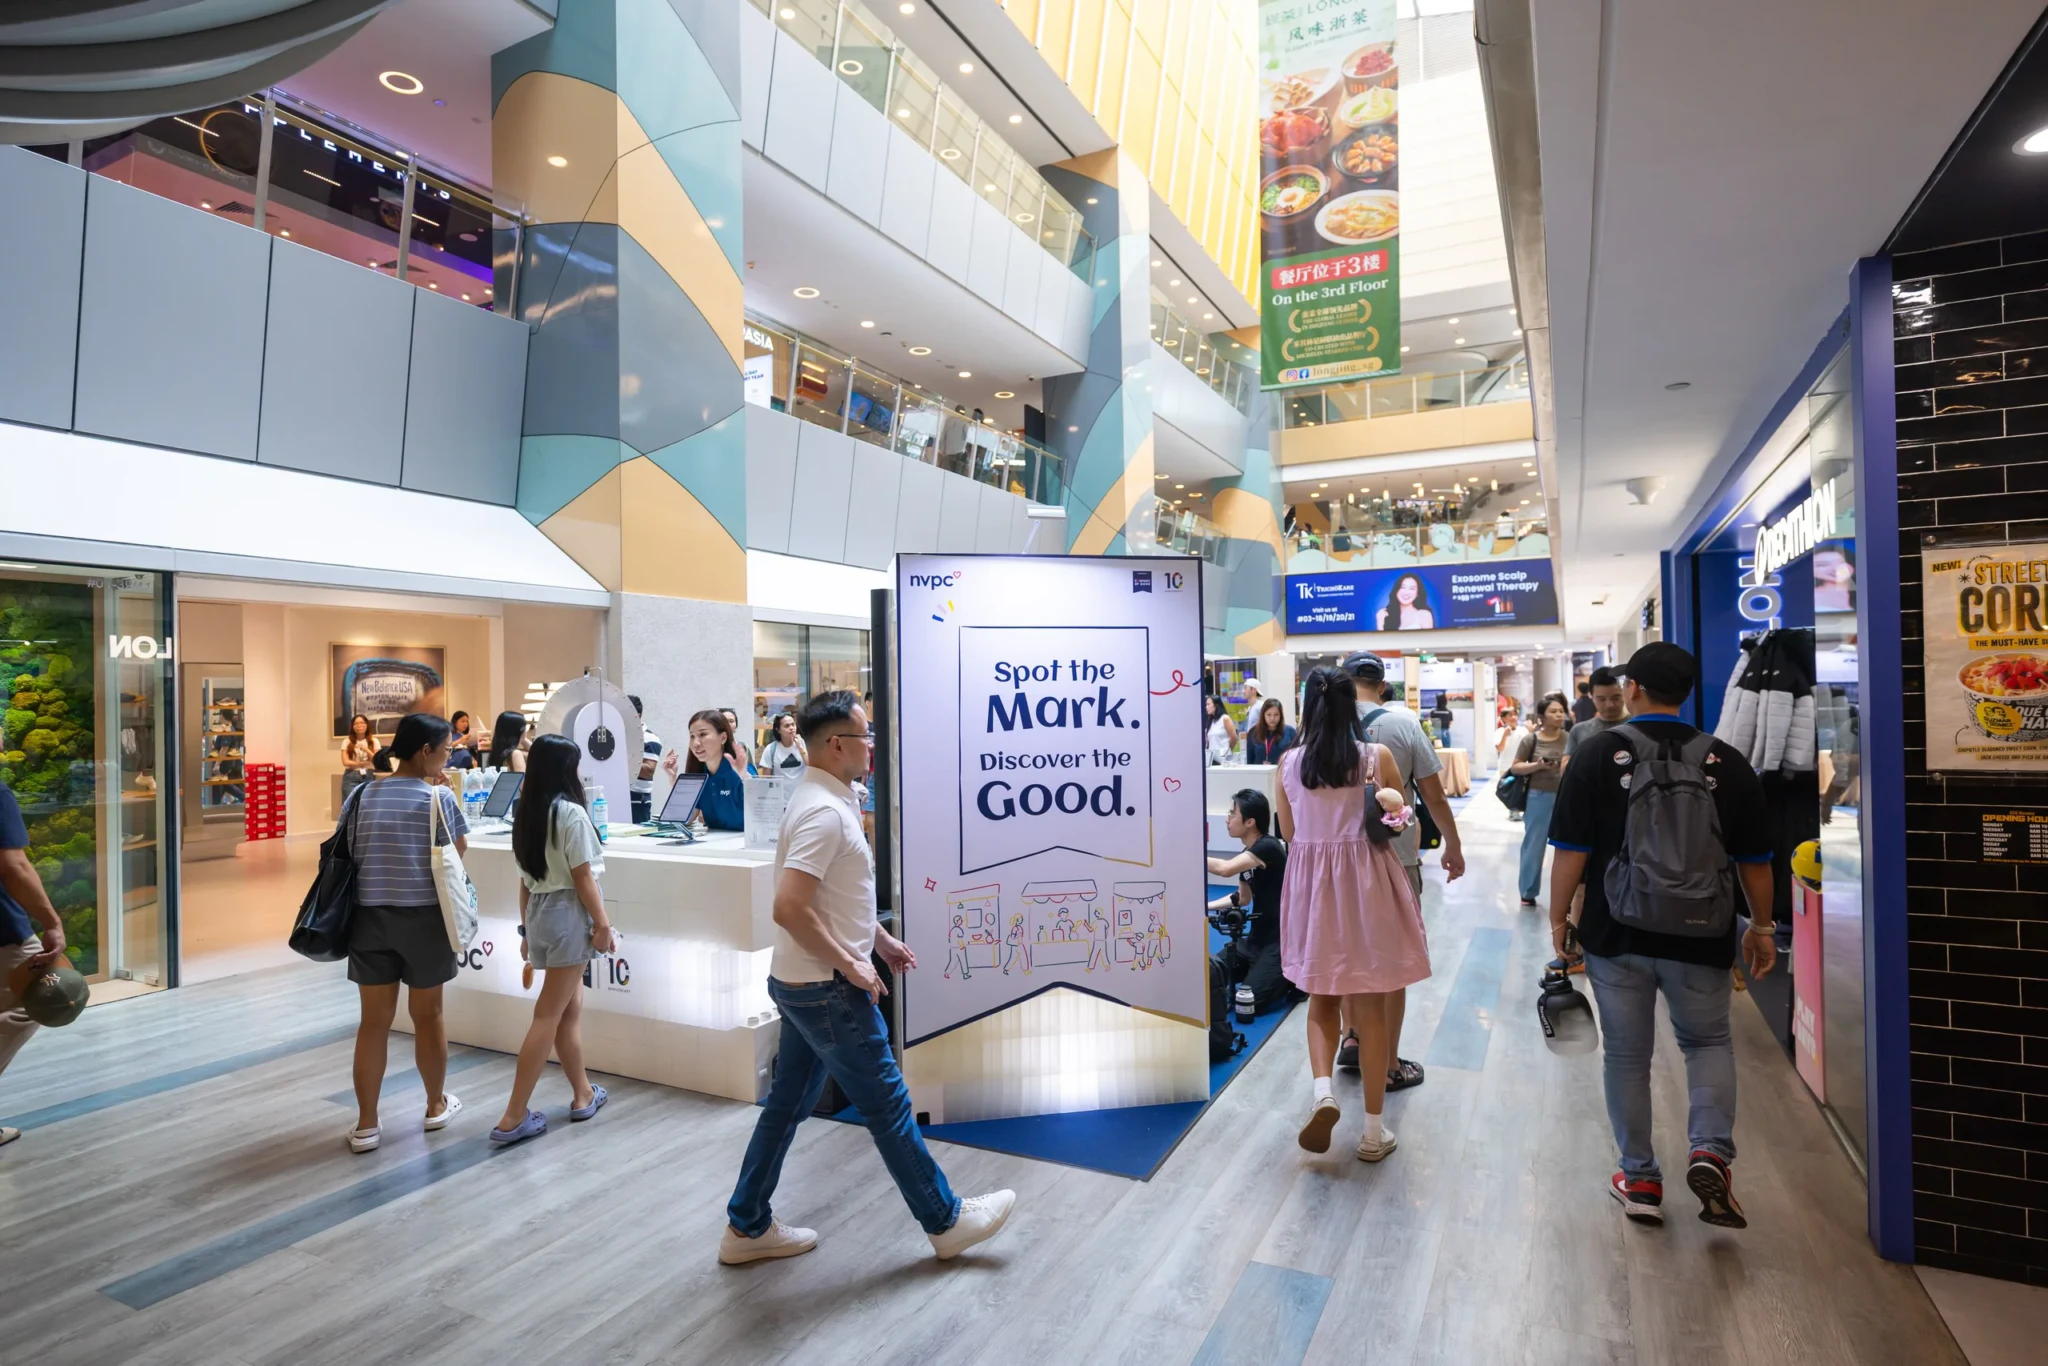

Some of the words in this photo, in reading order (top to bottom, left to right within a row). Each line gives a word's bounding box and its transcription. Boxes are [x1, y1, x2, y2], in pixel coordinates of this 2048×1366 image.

[1279, 254, 1380, 286] 餐厅位于3楼
[1272, 294, 1292, 306] On
[1296, 290, 1318, 302] the
[1321, 283, 1346, 298] 3rd
[1349, 279, 1388, 294] Floor
[743, 327, 774, 350] ASIA
[1932, 560, 1962, 572] NEW!
[910, 574, 954, 590] nvpc
[1164, 572, 1183, 589] 10
[1452, 574, 1496, 583] Exosome
[1498, 571, 1527, 581] Scalp
[1452, 583, 1494, 593] Renewal
[1496, 581, 1539, 592] Therapy
[1991, 638, 2039, 646] MUST-HAVE
[994, 660, 1062, 689] Spot
[1068, 660, 1116, 684] the
[375, 680, 398, 692] Balance
[399, 681, 413, 693] USA
[986, 686, 1140, 733] Mark.
[979, 751, 1086, 771] Discover
[1092, 748, 1131, 770] the
[977, 775, 1135, 820] Good.
[1982, 814, 2025, 822] OPENING
[608, 958, 629, 986] 10
